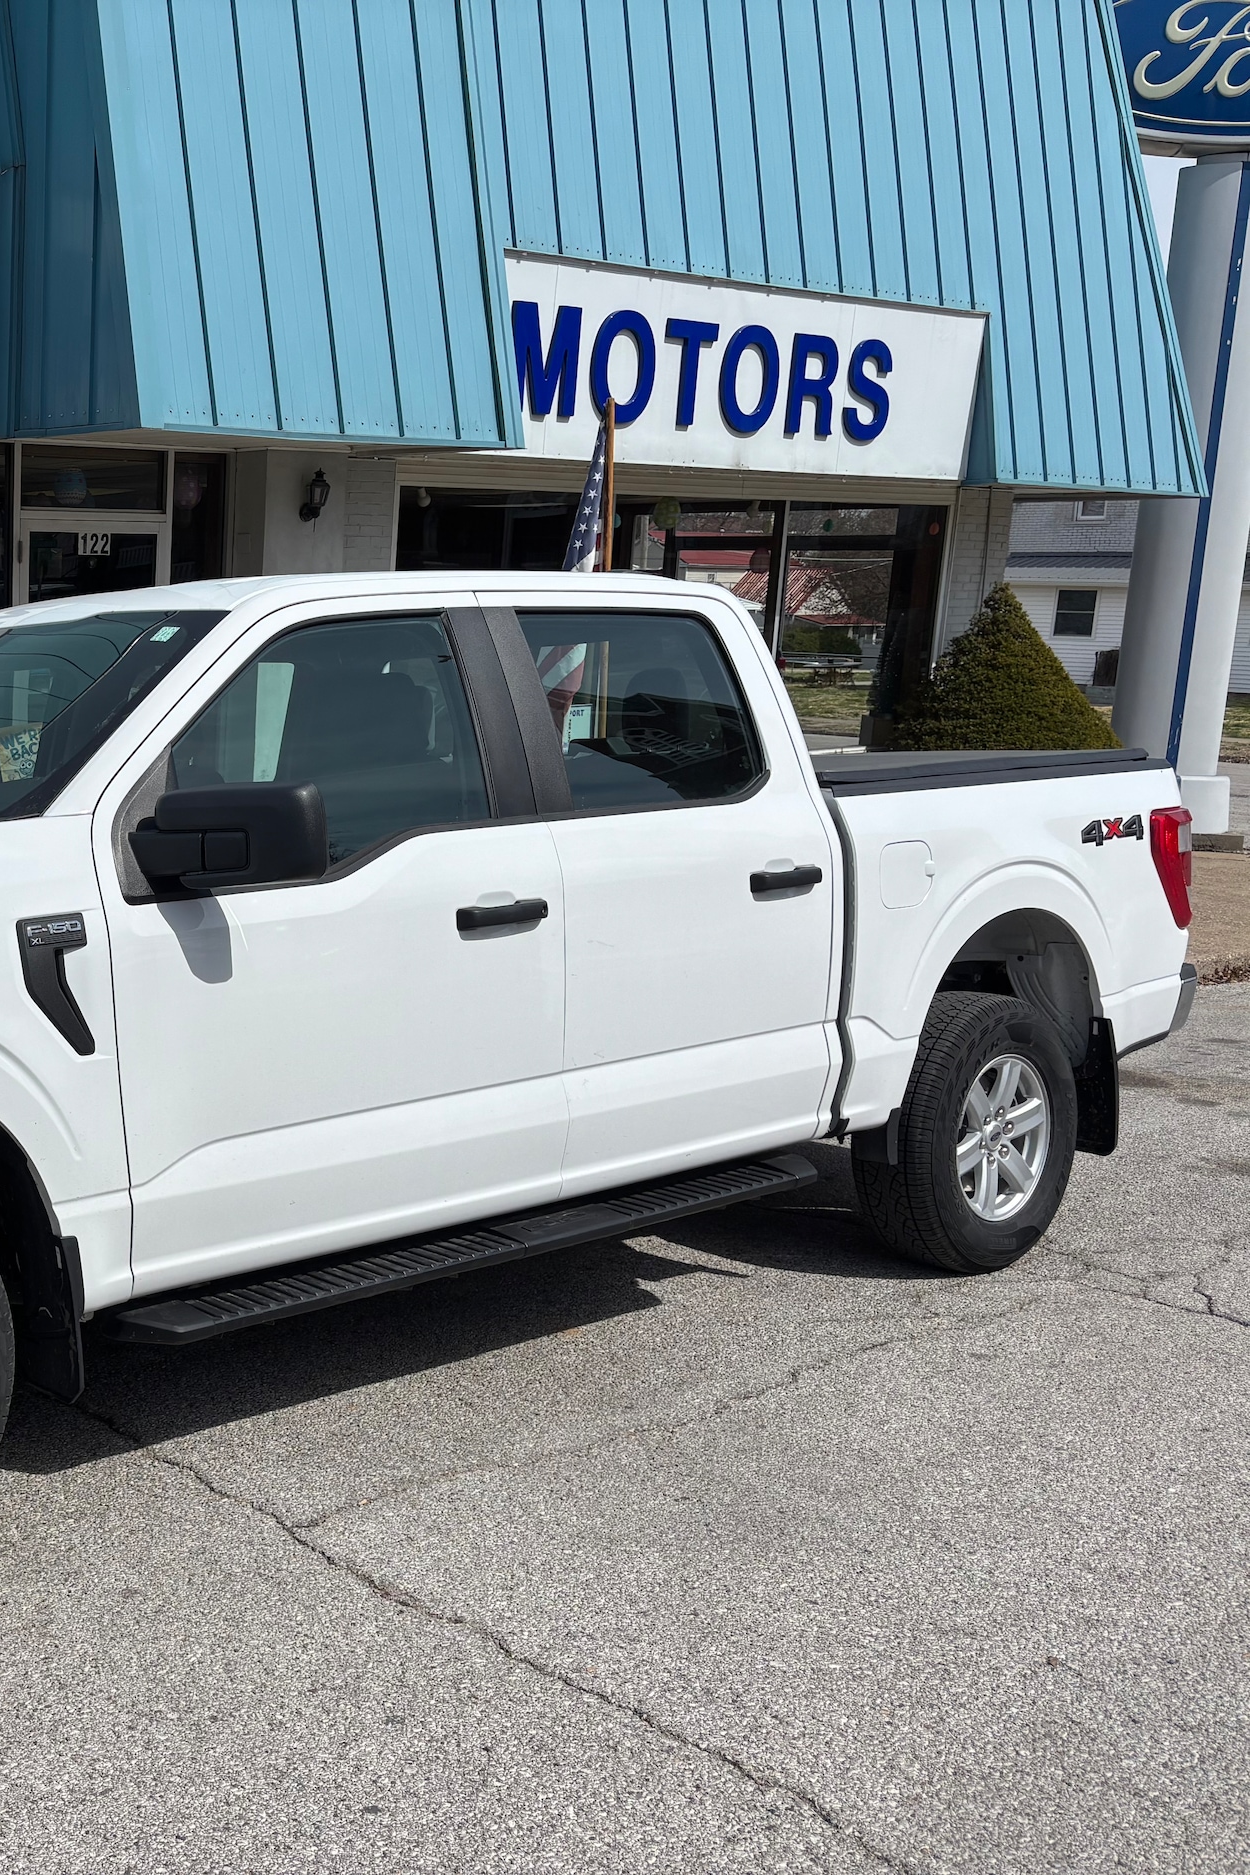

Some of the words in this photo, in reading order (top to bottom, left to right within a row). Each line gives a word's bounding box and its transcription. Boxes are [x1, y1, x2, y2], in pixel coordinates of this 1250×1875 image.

[1133, 0, 1250, 100] Fo
[511, 300, 893, 441] MOTORS
[81, 533, 110, 555] 122
[0, 728, 39, 750] WE'R
[9, 741, 38, 761] BAC
[27, 920, 82, 937] F-150
[30, 937, 45, 946] XL
